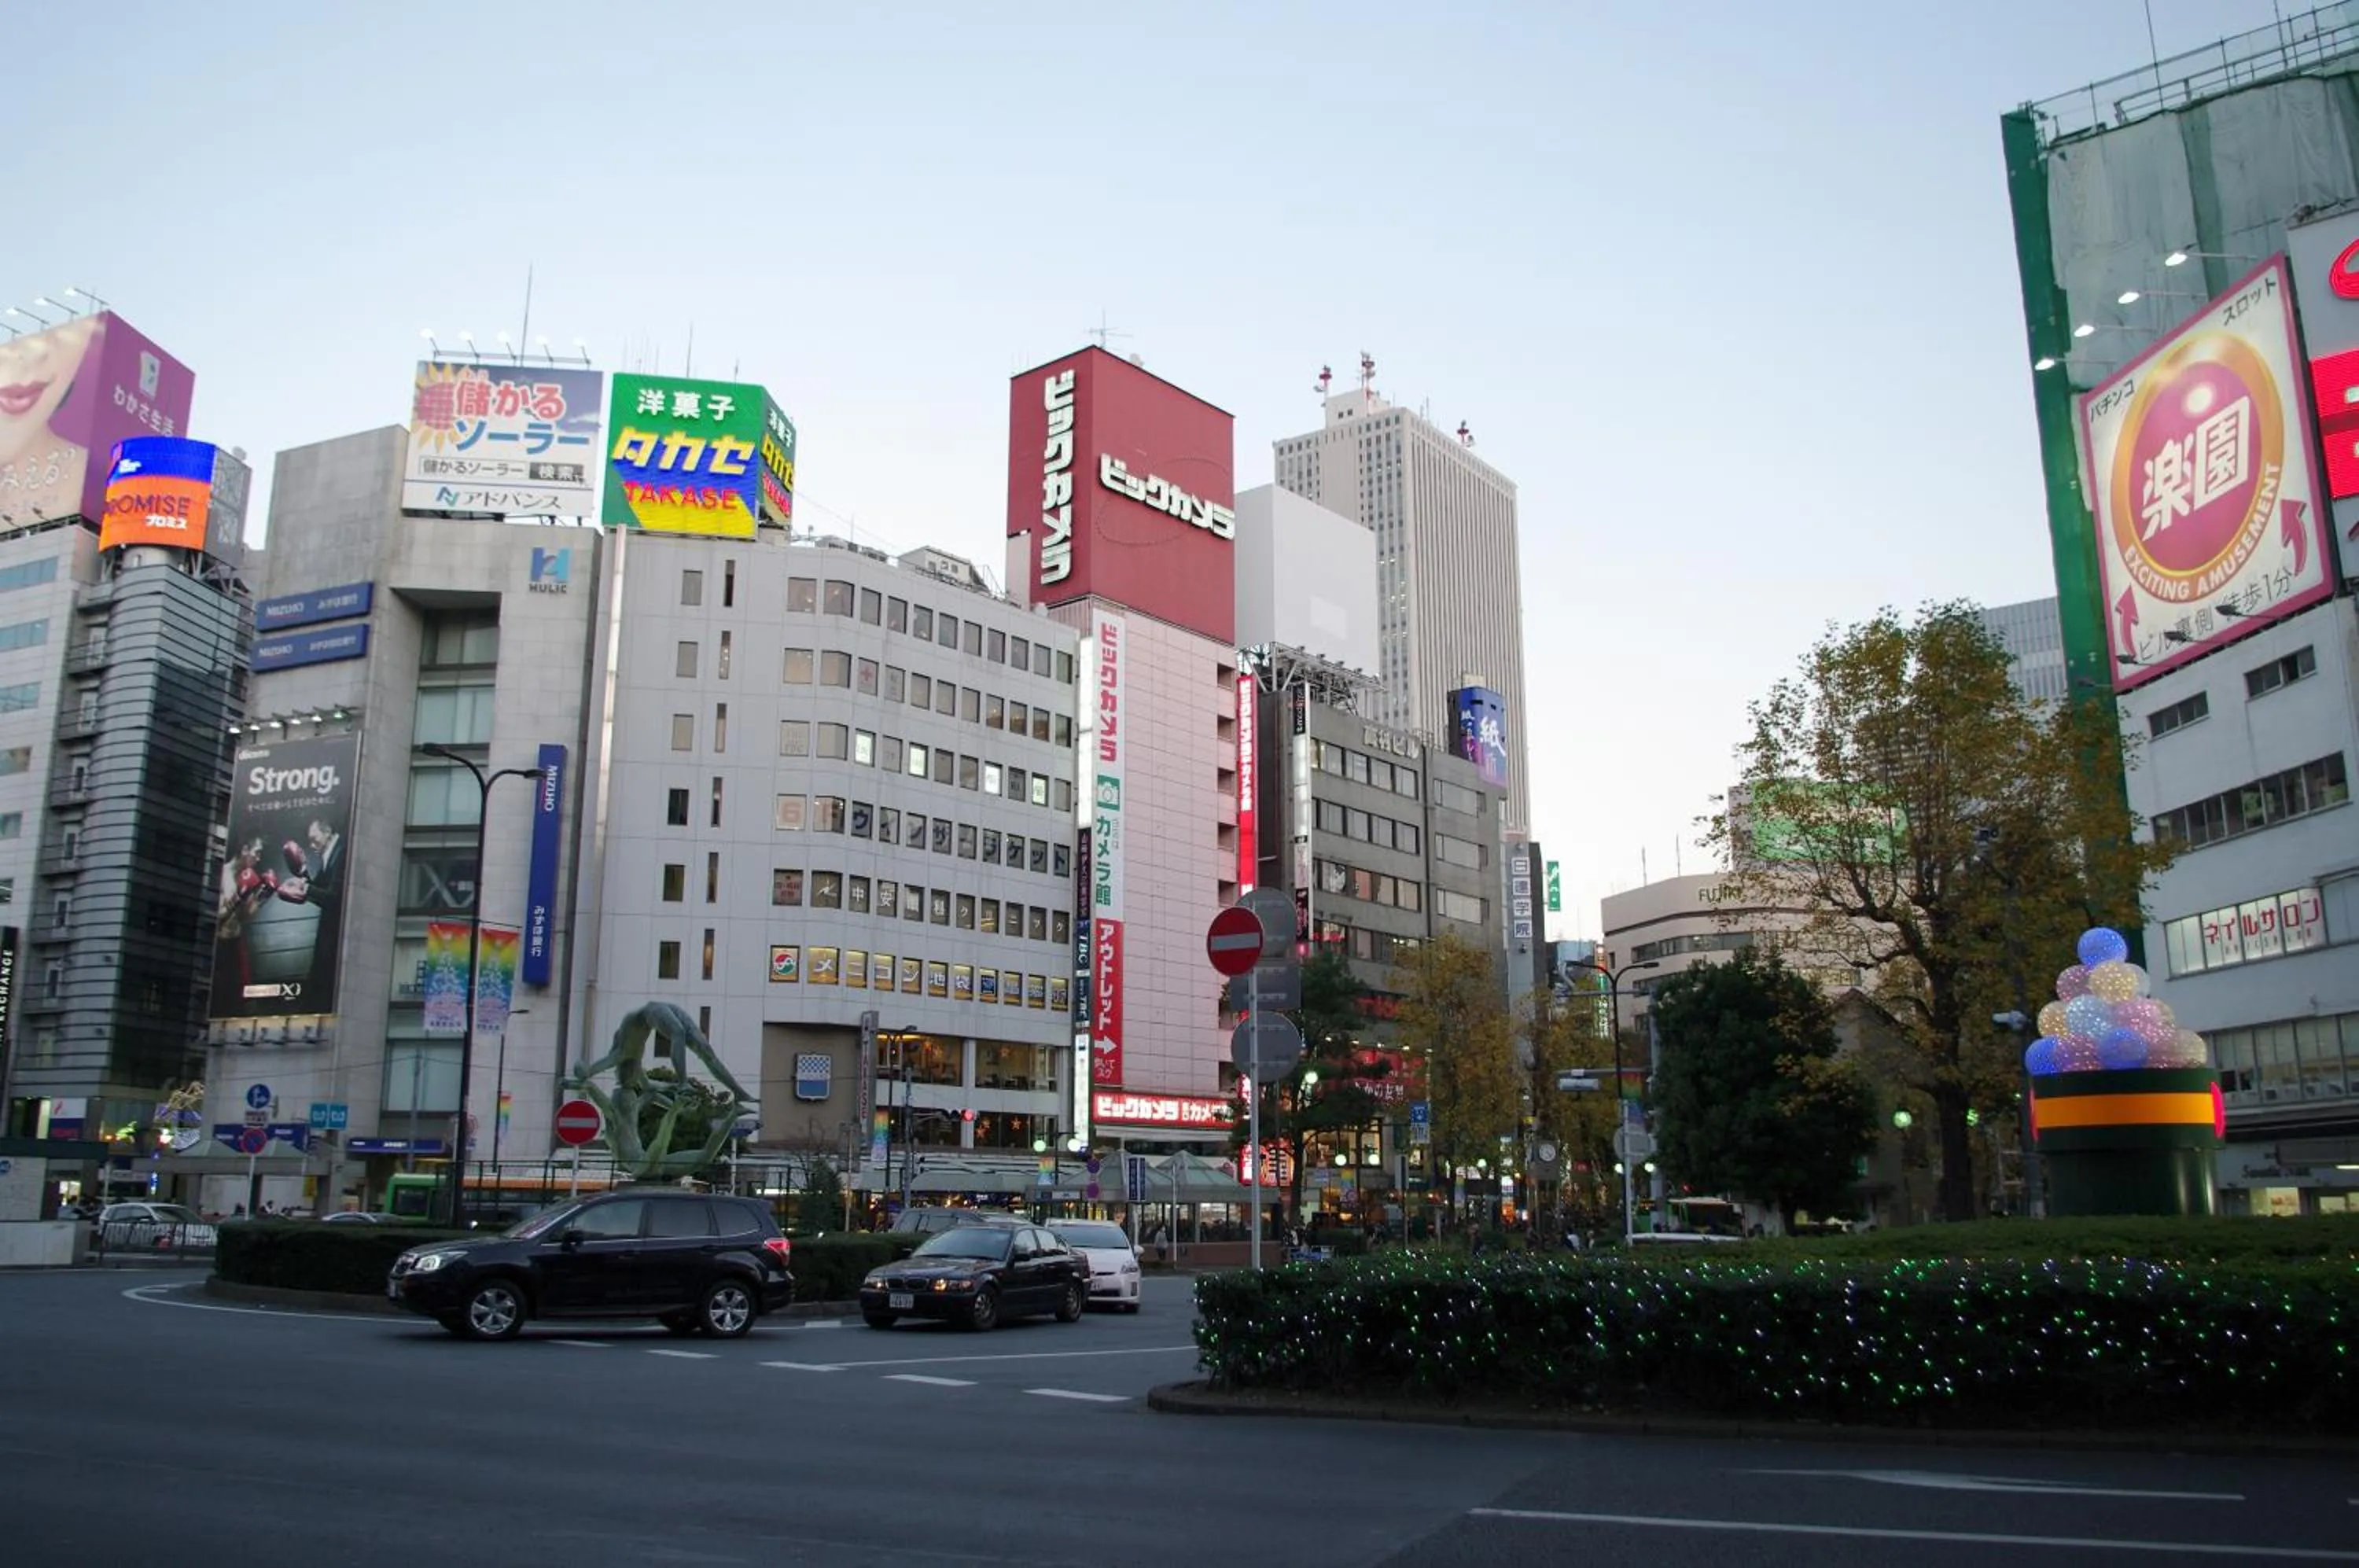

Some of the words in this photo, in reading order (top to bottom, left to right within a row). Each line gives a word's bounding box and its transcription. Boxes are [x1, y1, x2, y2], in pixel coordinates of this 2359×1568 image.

[2222, 277, 2278, 326] スロット
[113, 384, 175, 438] わかさ生活
[456, 381, 565, 420] 儲かる
[637, 388, 736, 423] 洋菓子
[2089, 378, 2136, 423] パチンコ
[455, 419, 590, 455] ソーラー
[612, 426, 756, 476] タカセ
[423, 458, 524, 477] 儲かるソーラー
[761, 432, 794, 493] タカセ
[1040, 369, 1076, 585] ビックカメラ
[2141, 394, 2251, 542] 楽園
[464, 491, 562, 510] アドバンス
[624, 480, 739, 510] TAKASE
[1100, 453, 1236, 540] ビックカメラ
[2124, 545, 2191, 600] EXCITING
[2196, 462, 2283, 596] AMUSEMENT
[529, 583, 567, 594] HULIC
[1099, 622, 1119, 763] ビックカメラ
[248, 765, 340, 795] Strong.
[544, 764, 558, 812] MIZUHO
[1095, 815, 1111, 907] カメラ館
[2203, 897, 2320, 944] ネイルサロン
[1079, 933, 1088, 964] TBC
[1098, 923, 1115, 1031] アウトレット
[1098, 1095, 1179, 1121] ビックカメラ
